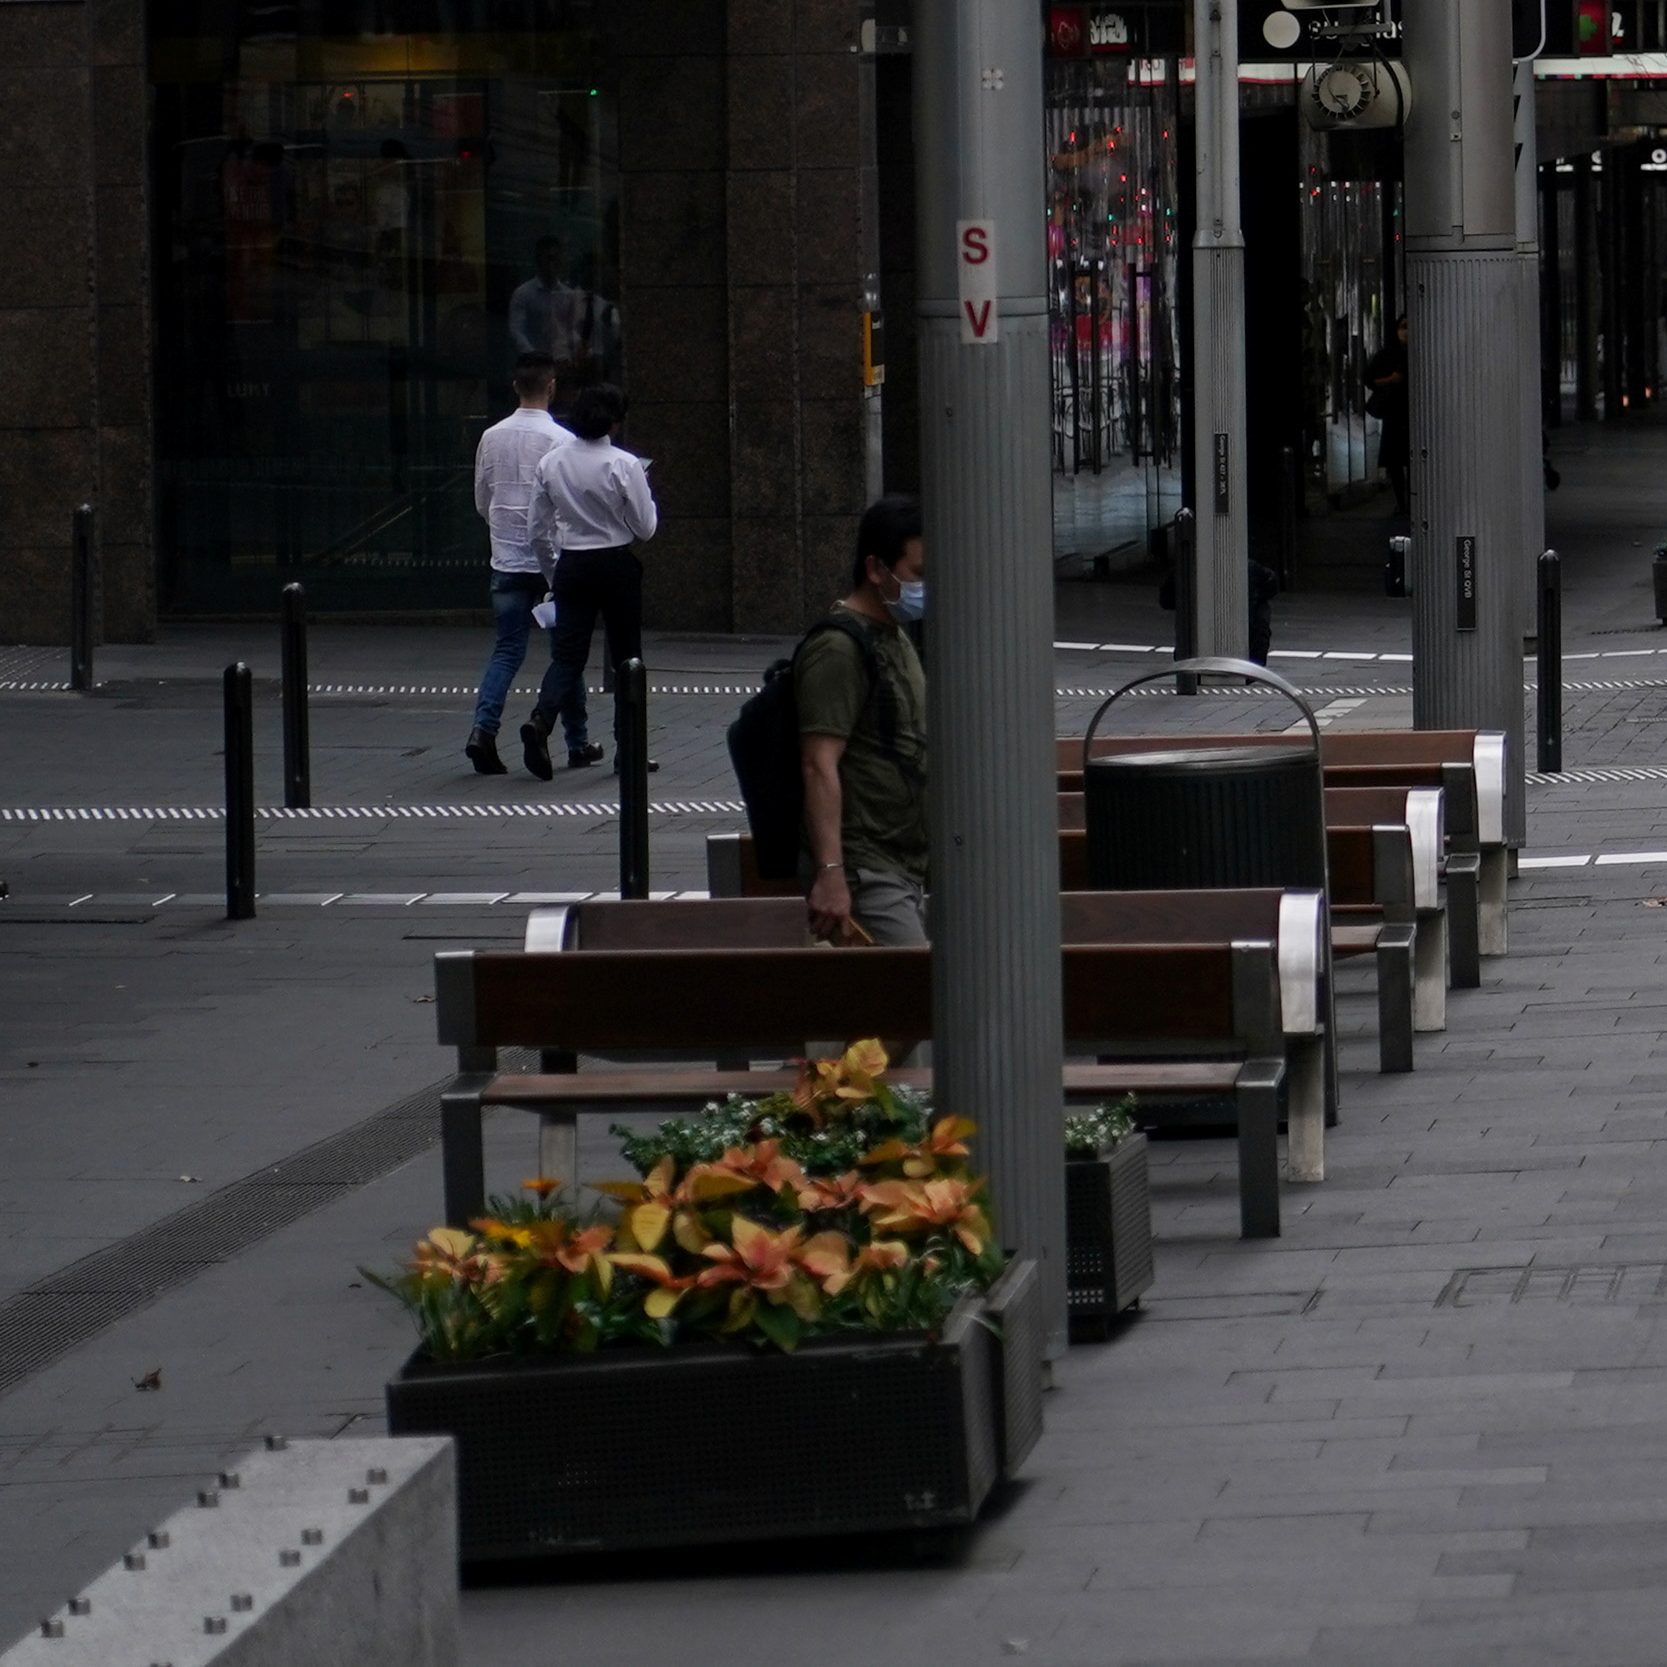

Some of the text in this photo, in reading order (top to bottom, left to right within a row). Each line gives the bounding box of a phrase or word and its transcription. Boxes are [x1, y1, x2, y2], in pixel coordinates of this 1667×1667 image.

[962, 227, 988, 264] S
[964, 300, 991, 338] V
[1462, 539, 1472, 568] George
